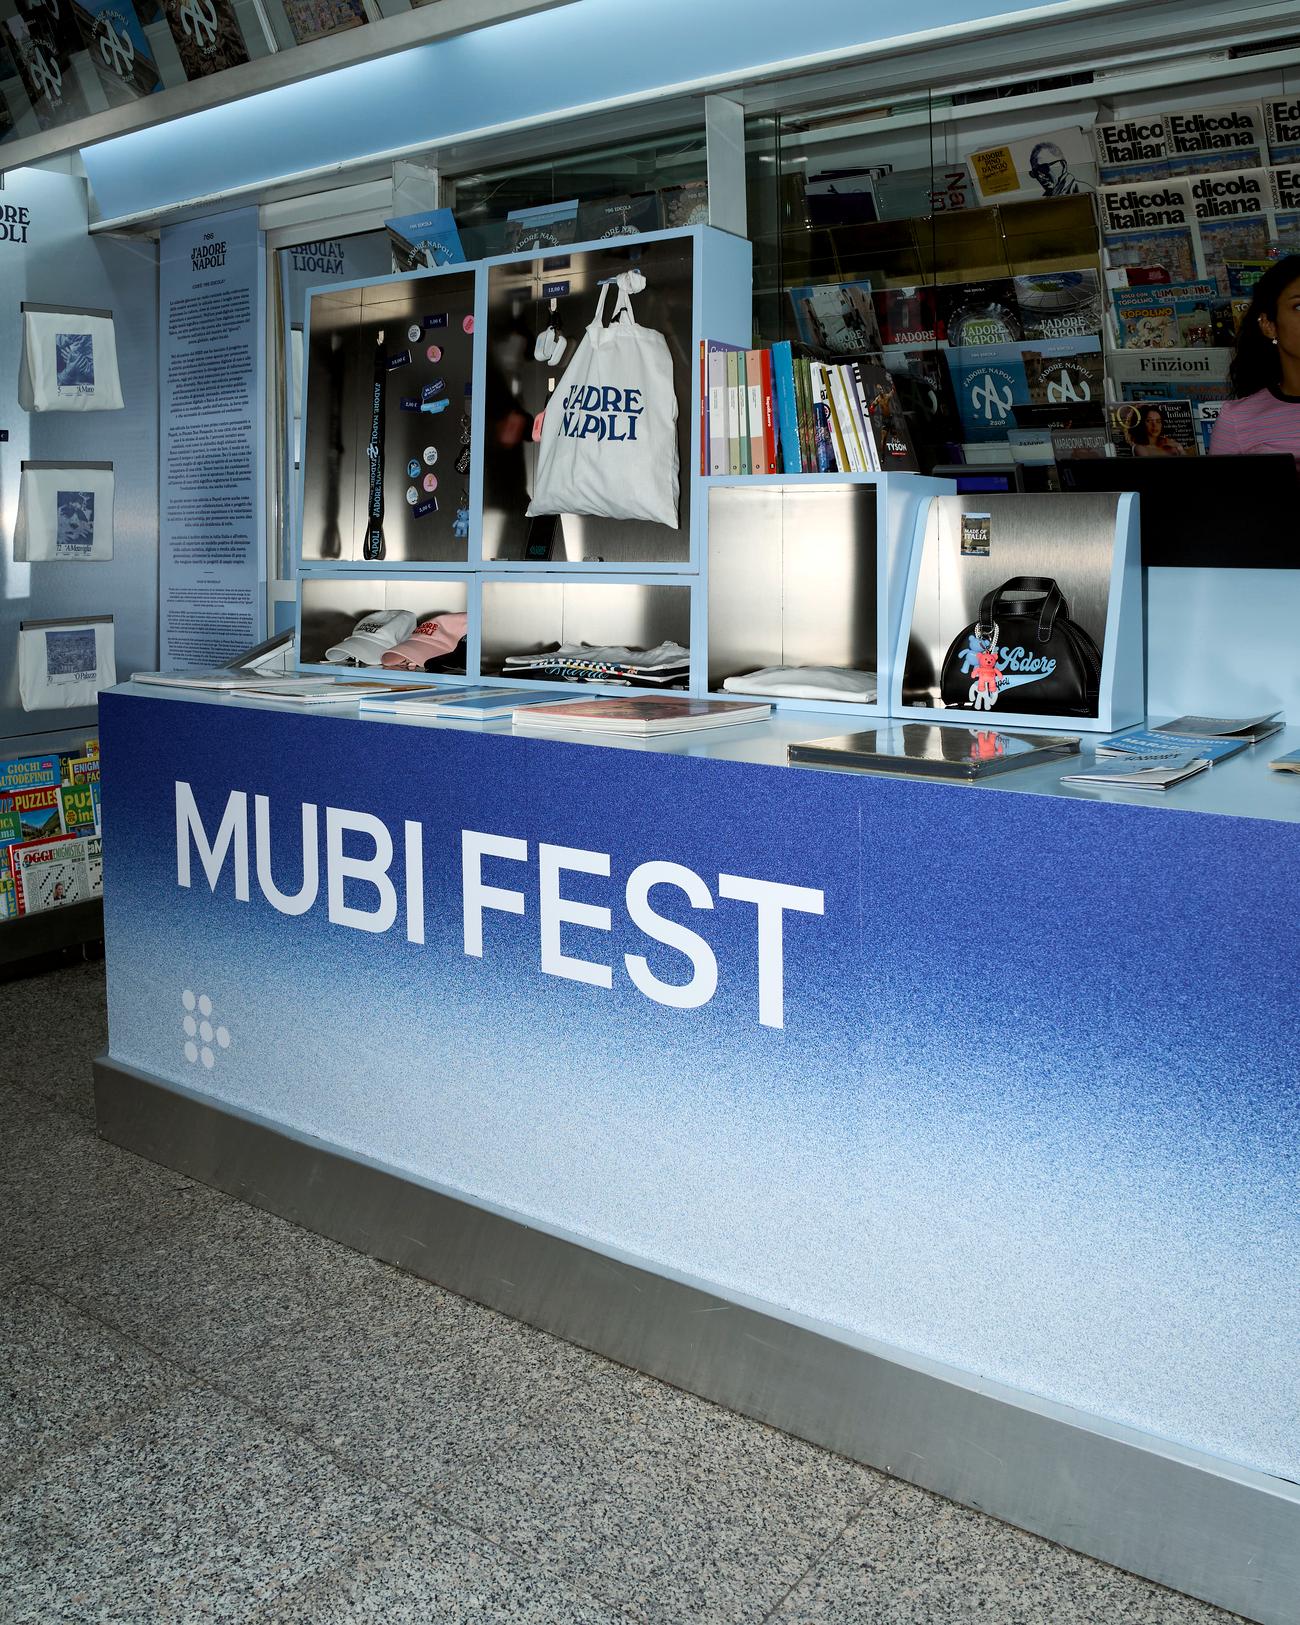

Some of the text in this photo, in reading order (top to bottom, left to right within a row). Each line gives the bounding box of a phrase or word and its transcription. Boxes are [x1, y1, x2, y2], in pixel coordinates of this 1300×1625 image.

[1171, 112, 1254, 134] Edicola
[1173, 132, 1254, 153] Italiana
[1105, 189, 1184, 211] Edicola
[1108, 209, 1185, 229] Italiana
[191, 241, 226, 259] J'ADORE
[192, 254, 226, 272] NAPOLI
[1120, 308, 1173, 319] TOPOLINO
[1039, 362, 1093, 383] J'ADORE NAPOLI
[1140, 357, 1210, 371] Finzioni
[963, 367, 1015, 388] J'ADORE NAPOLI
[886, 443, 907, 452] TYSON
[964, 533, 988, 541] ITALIA
[7, 761, 41, 774] GIOCHI
[24, 849, 53, 863] OGGI
[175, 780, 825, 1030] MUBI FEST
